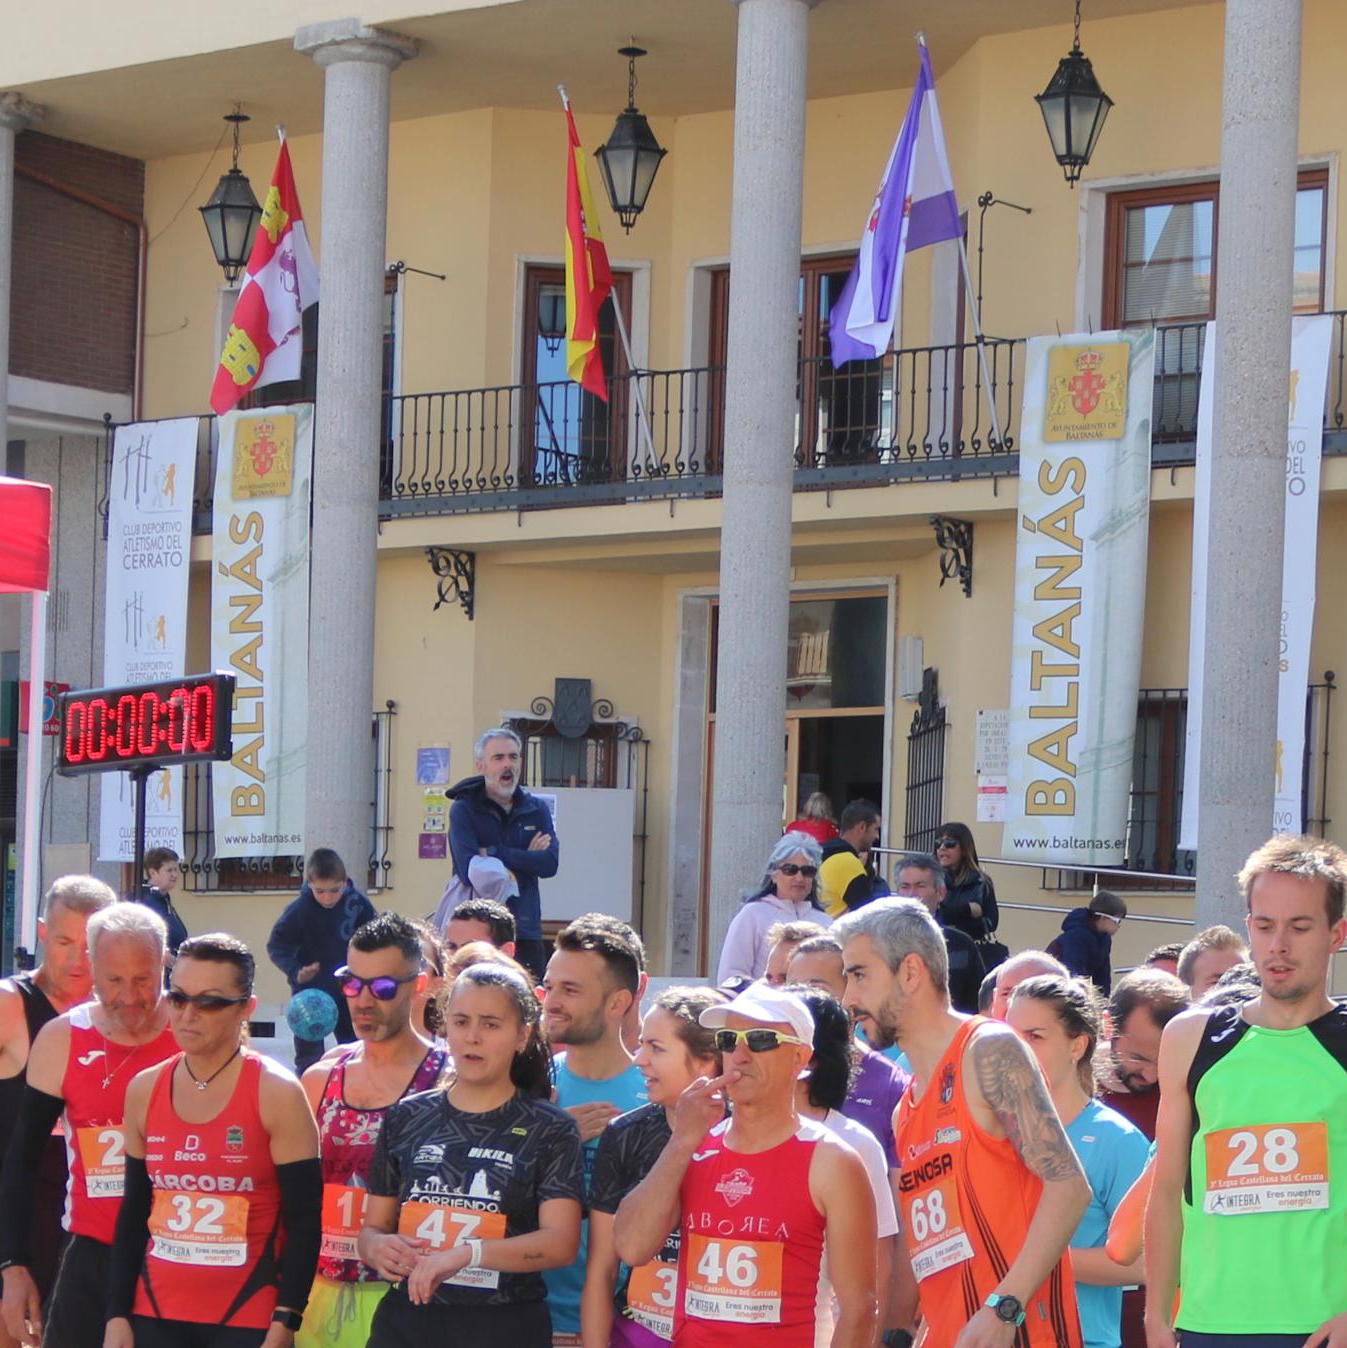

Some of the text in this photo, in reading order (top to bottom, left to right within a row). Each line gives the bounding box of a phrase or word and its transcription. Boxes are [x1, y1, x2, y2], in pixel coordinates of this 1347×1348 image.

[123, 521, 182, 537] CLUB DEPORTIVO
[123, 535, 182, 552] ATLETISMO DEL
[123, 551, 182, 570] CERRATO
[1023, 456, 1086, 817] BALTANÁS
[219, 511, 266, 817] BALTANÁS
[65, 685, 214, 763] 00:00:00
[144, 827, 179, 838] EPORTIVO
[225, 831, 302, 847] www.baltanas.es
[98, 1130, 125, 1167] 2
[174, 1151, 206, 1162] Beco
[1227, 1128, 1299, 1177] 28
[149, 1169, 254, 1192] ÁRCOBA
[1227, 1193, 1260, 1208] INTEGRA
[1267, 1188, 1321, 1199] Eres nuestra
[167, 1194, 225, 1235] 32
[910, 1189, 947, 1242] 68
[416, 1209, 481, 1249] 47
[697, 1242, 758, 1288] 46
[652, 1267, 678, 1308] 3
[725, 1300, 774, 1312] Eres nuestra
[645, 1318, 672, 1334] INTEGR
